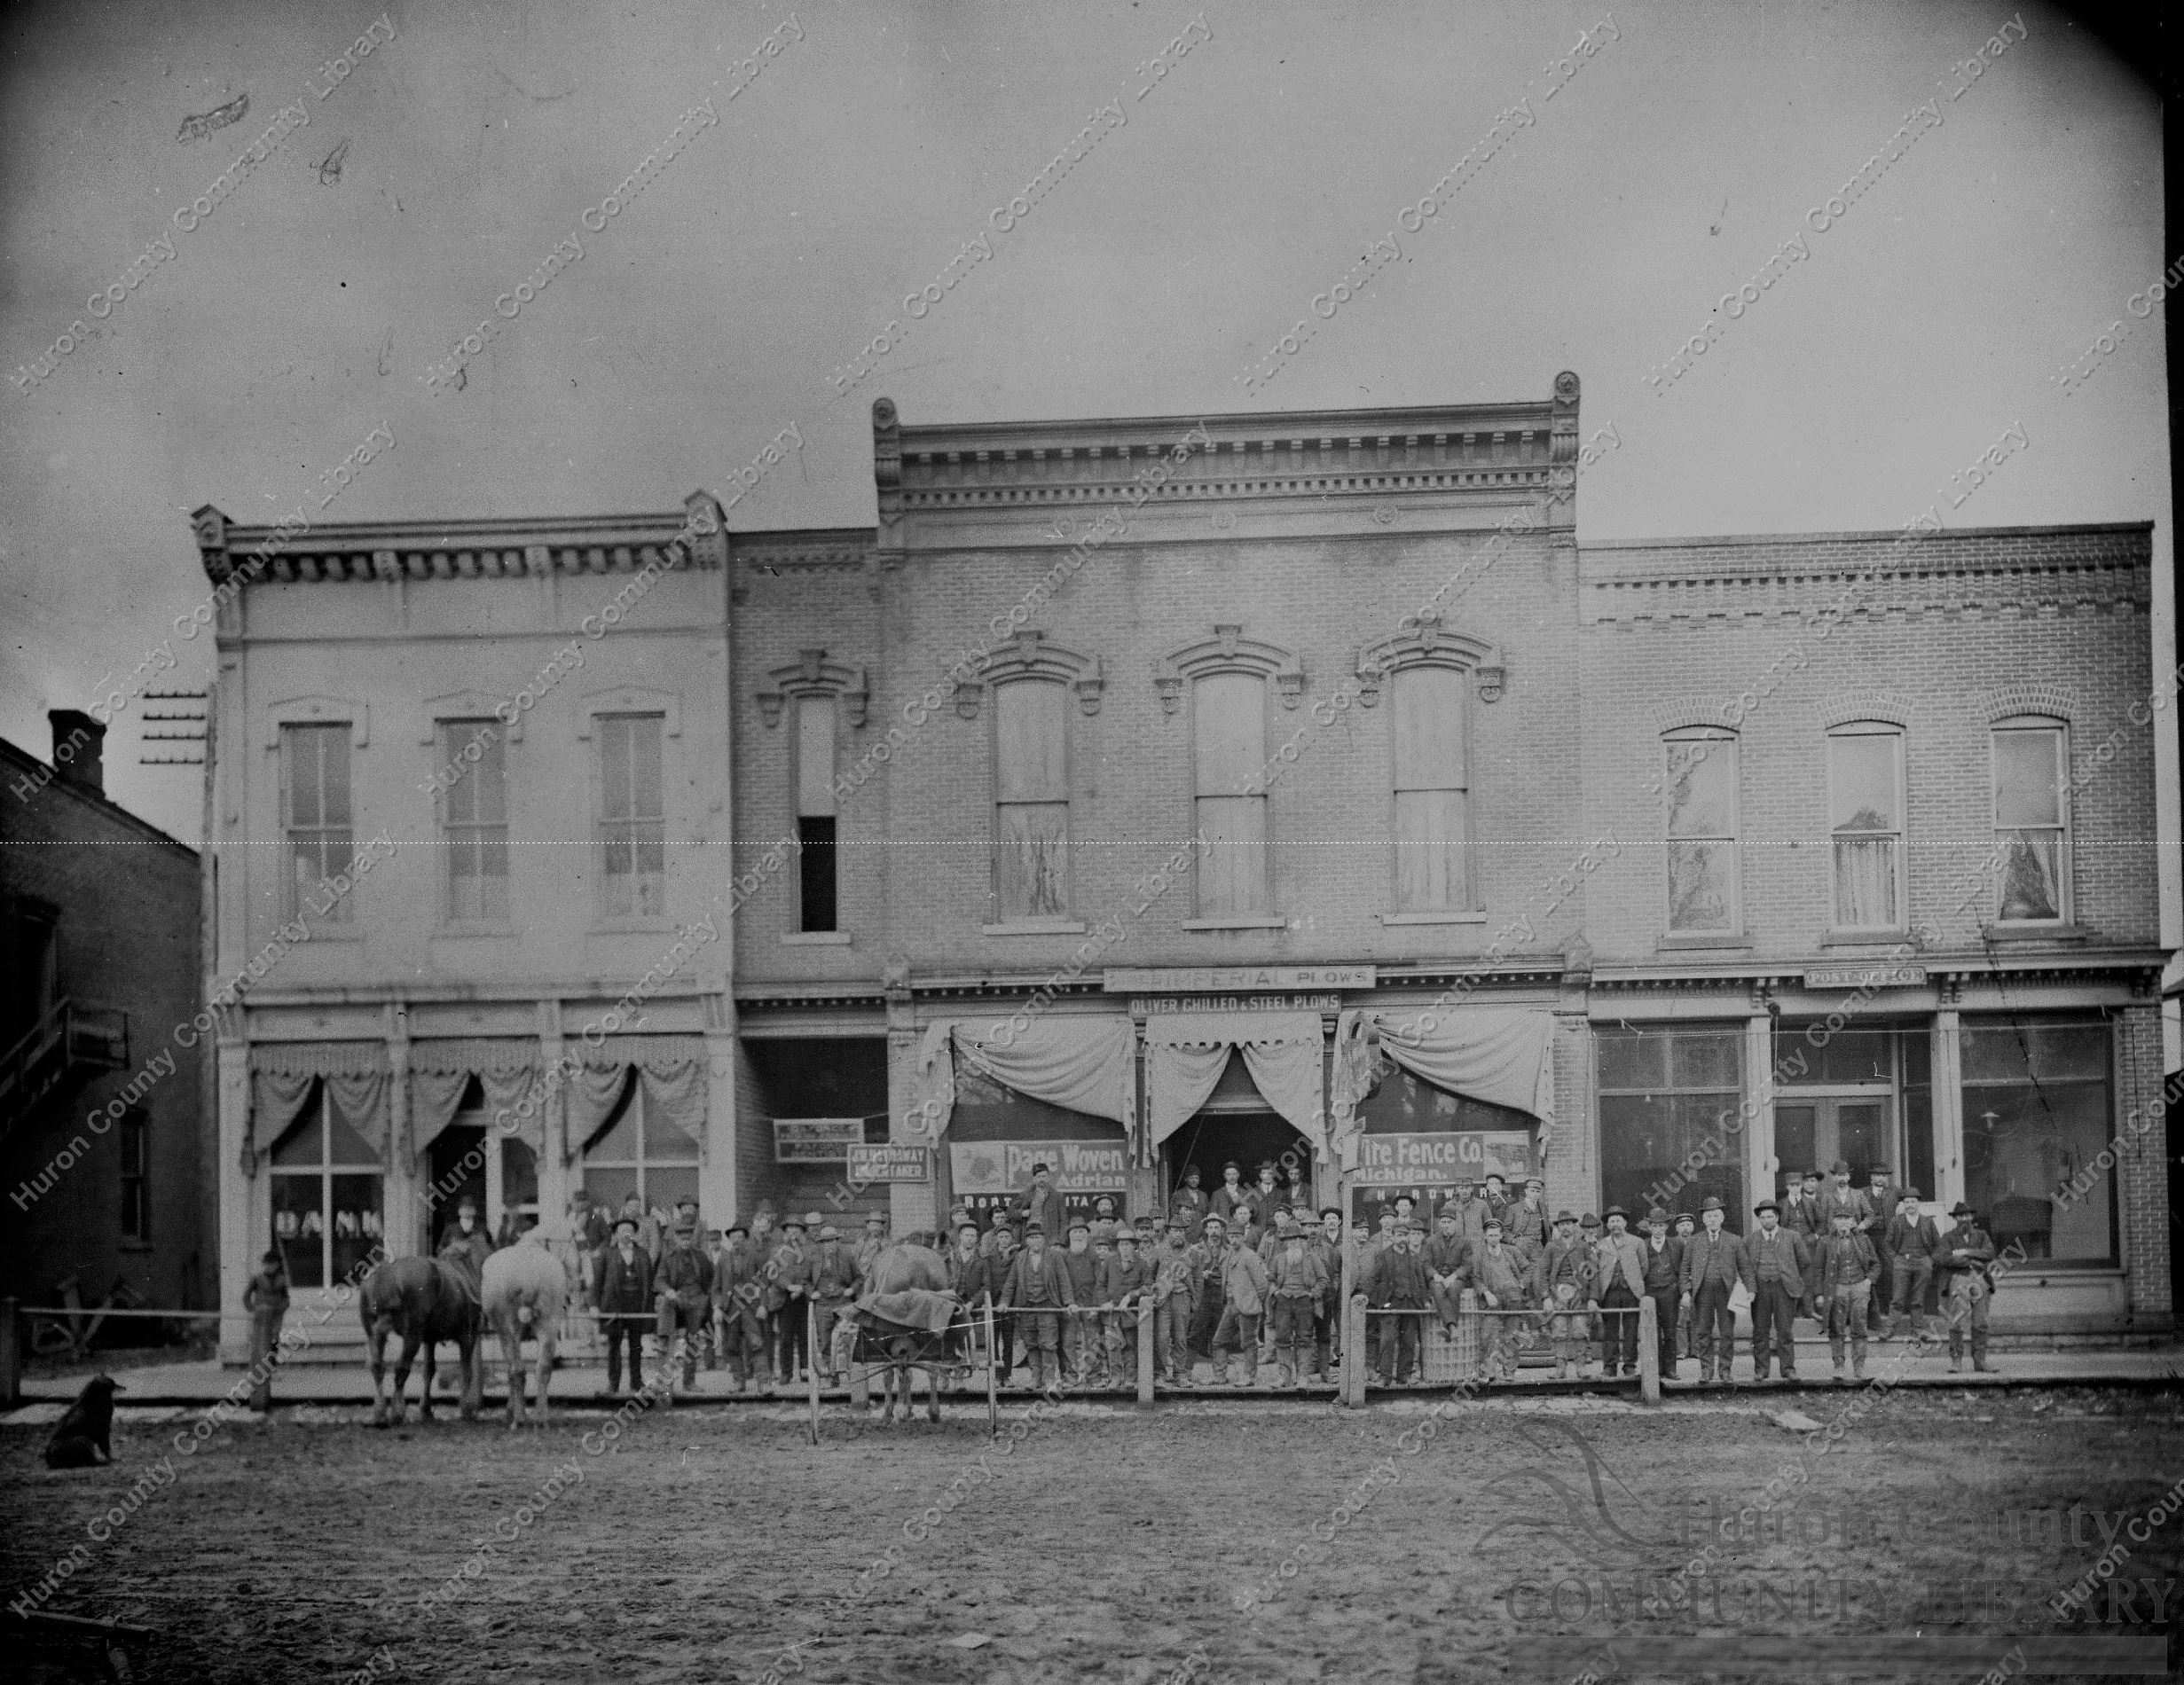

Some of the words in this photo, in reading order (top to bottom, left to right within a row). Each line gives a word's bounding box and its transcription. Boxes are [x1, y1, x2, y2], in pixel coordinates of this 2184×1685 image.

[1297, 971, 1367, 984] PLOWS
[1131, 999, 1177, 1014] OLIVER
[1182, 998, 1237, 1013] CHILLED
[1250, 996, 1287, 1011] STEEL
[1294, 994, 1339, 1010] PLOWS
[1063, 1145, 1124, 1172] Woven
[1397, 1137, 1456, 1165] Fence
[1056, 1173, 1127, 1187] Adrian
